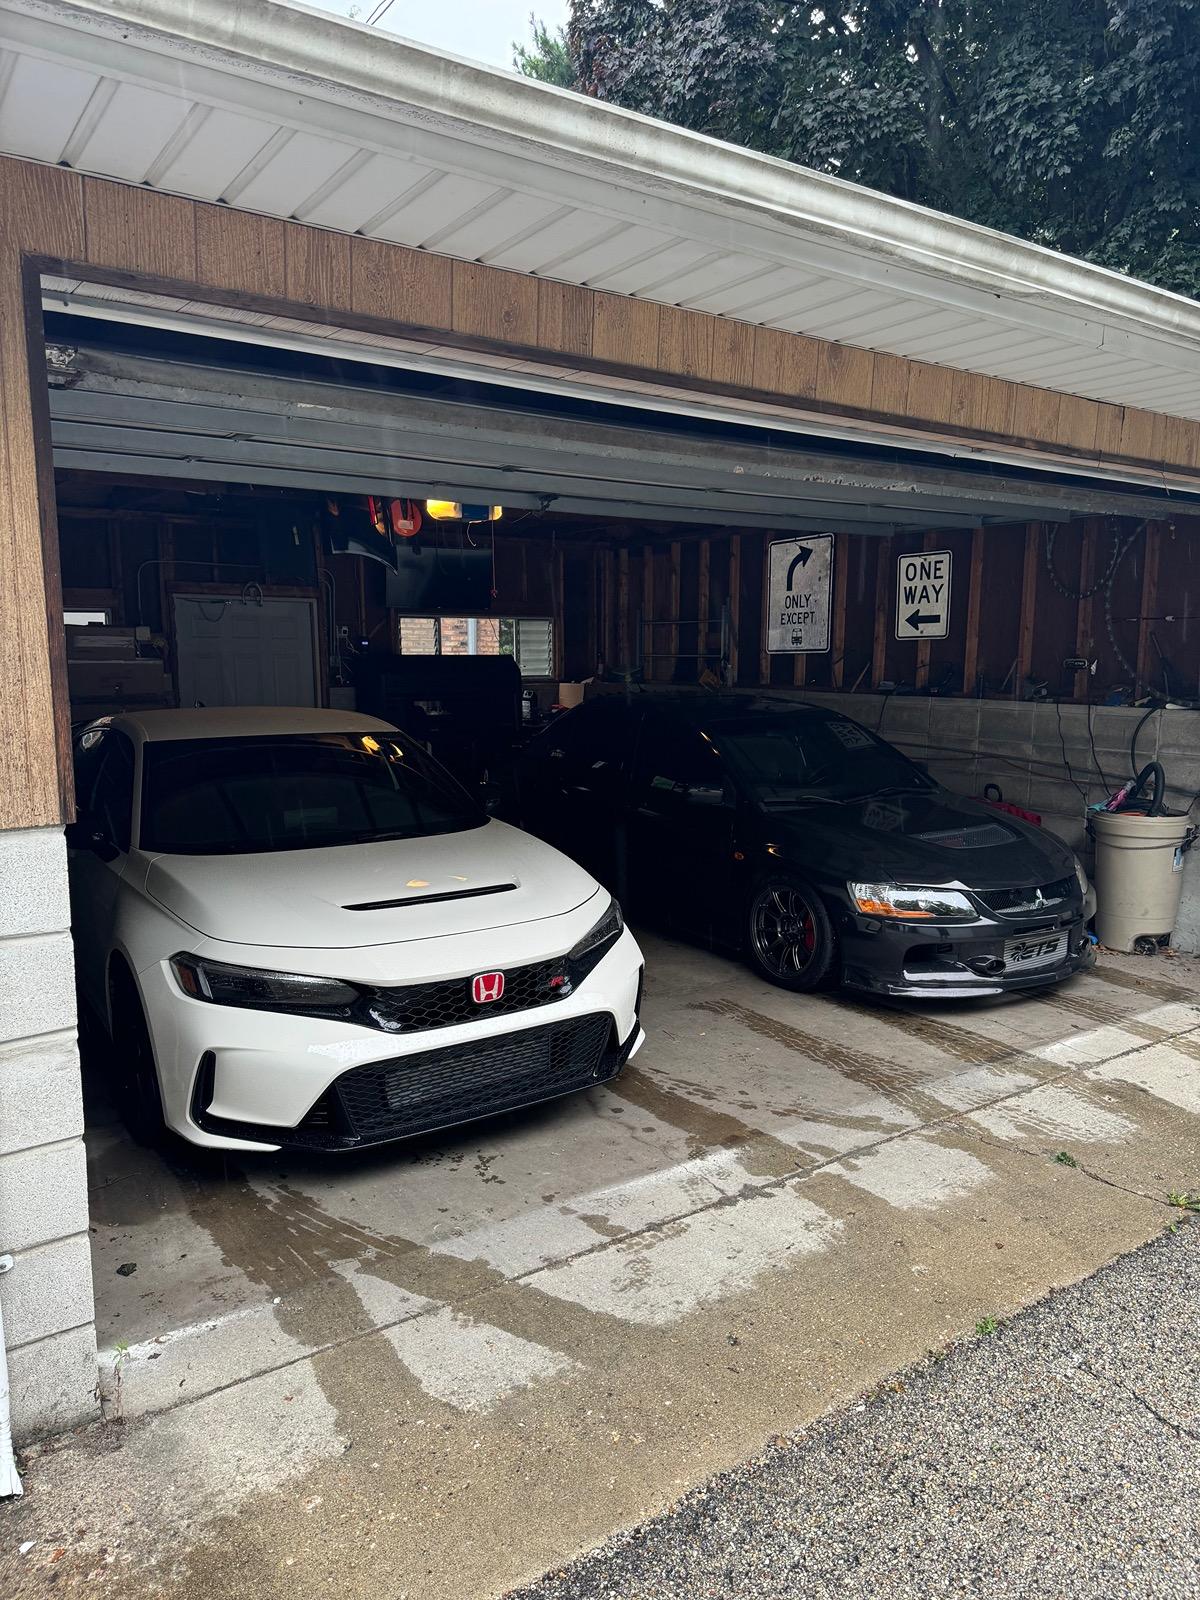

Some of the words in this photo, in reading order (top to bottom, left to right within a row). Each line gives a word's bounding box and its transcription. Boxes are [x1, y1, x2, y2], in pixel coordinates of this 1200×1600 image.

[905, 559, 944, 582] ONE
[785, 593, 812, 610] ONLY
[904, 583, 944, 605] WAY
[780, 611, 816, 625] EXCEPT
